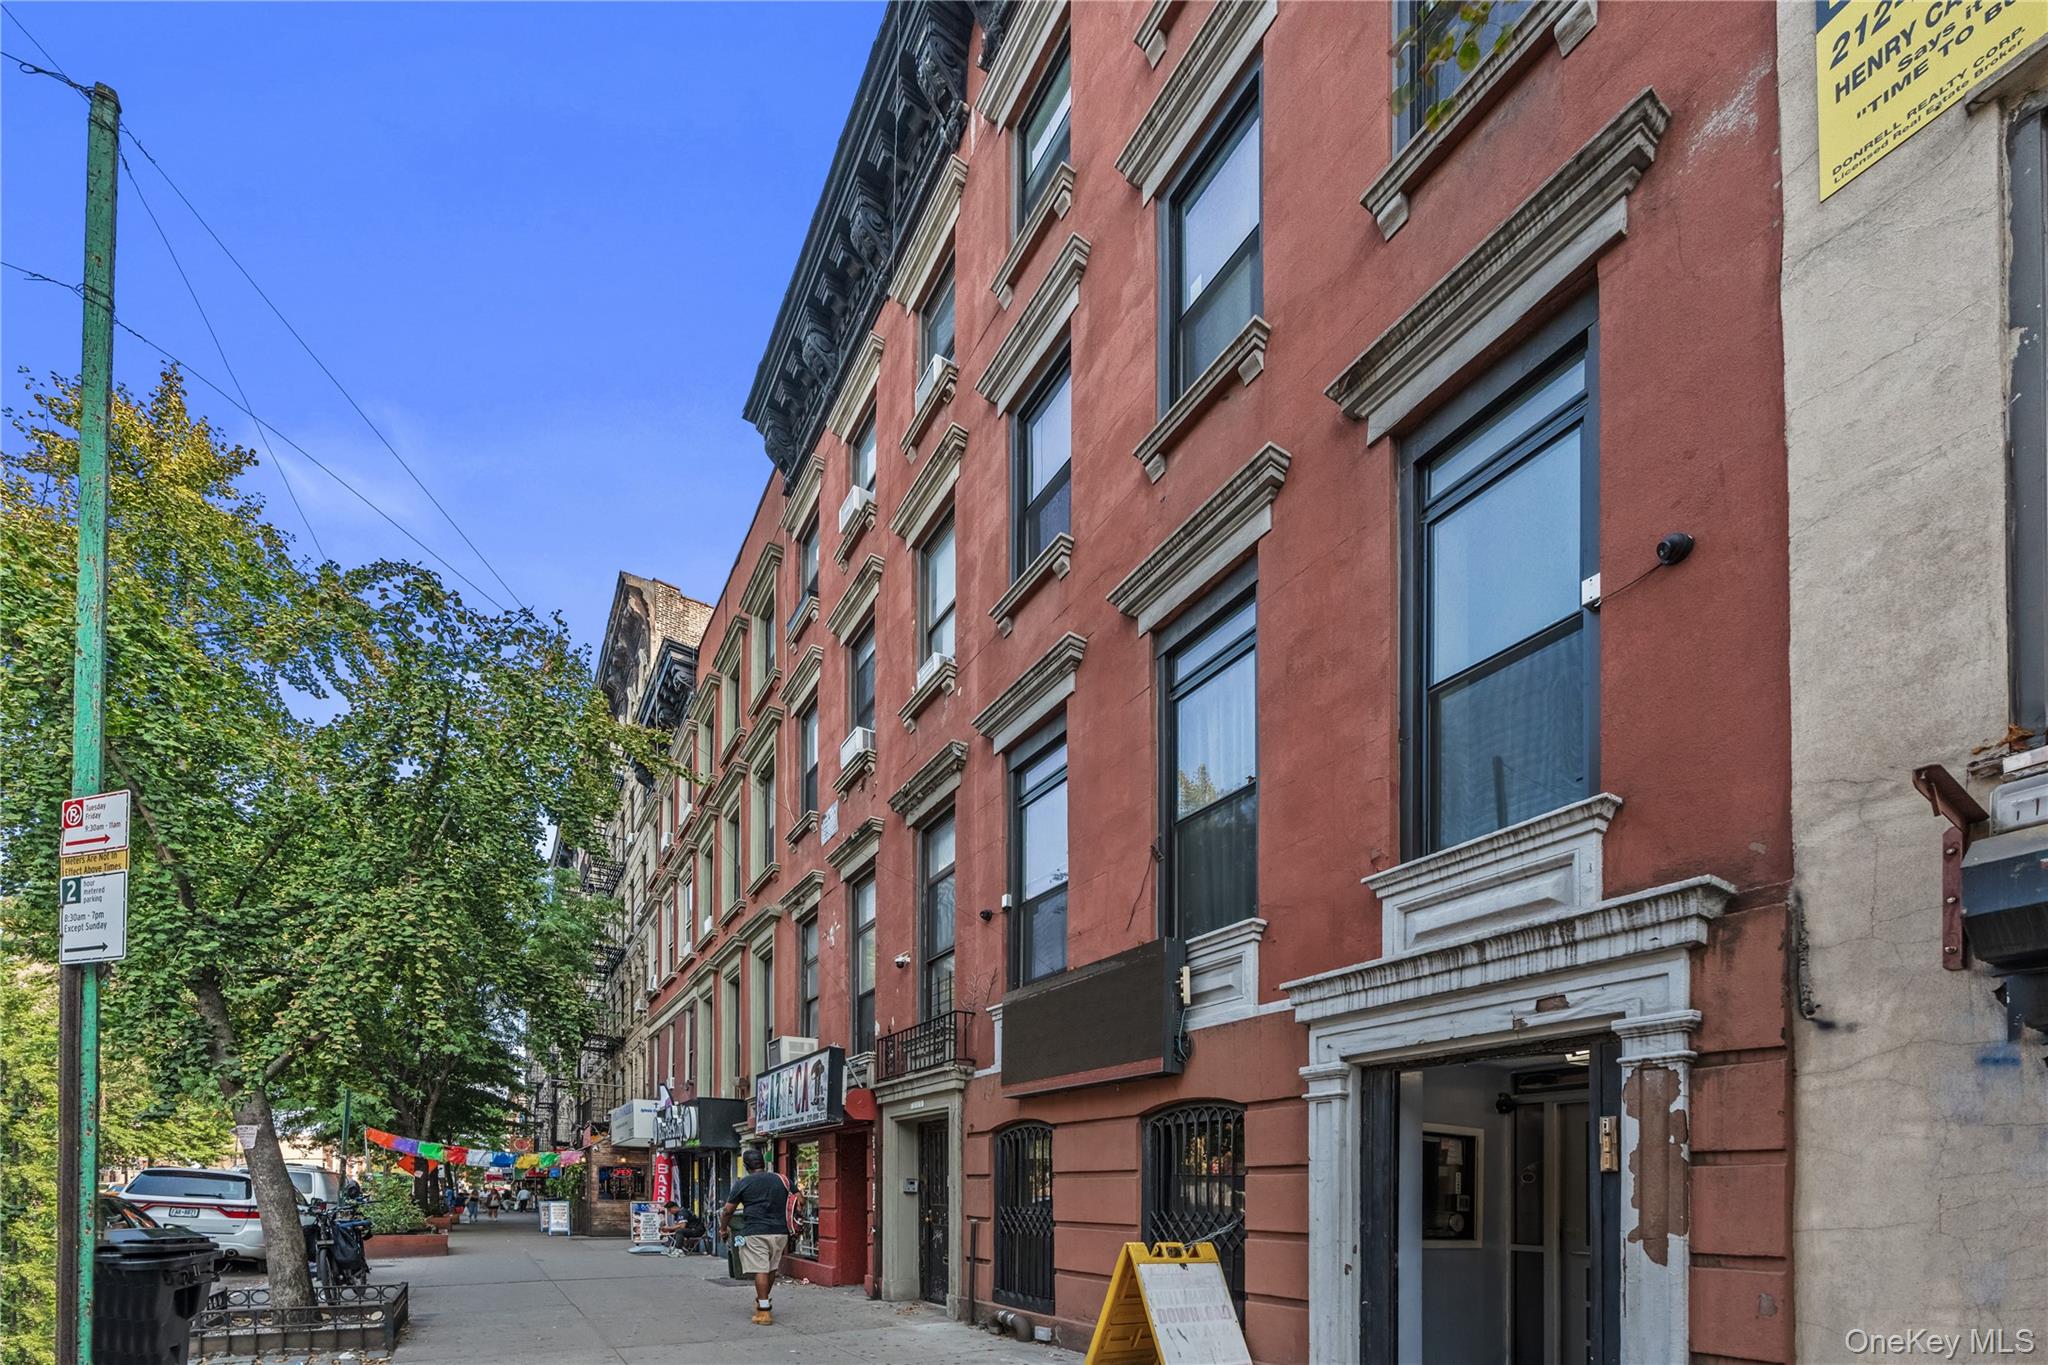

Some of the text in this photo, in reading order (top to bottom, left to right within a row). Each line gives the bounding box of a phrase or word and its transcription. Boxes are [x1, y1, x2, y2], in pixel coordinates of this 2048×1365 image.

[1897, 22, 1956, 72] says
[1937, 25, 1974, 57] TO
[1835, 19, 1917, 104] HENRY
[1832, 26, 2026, 176] DONRELL REALTY CORP.
[1833, 38, 2024, 184] Licensed Real Estate Broker
[85, 803, 106, 812] Tuesday
[85, 812, 101, 820] Friday
[85, 823, 104, 833] 9:30am
[64, 852, 118, 866] Meters Are Not In
[64, 863, 122, 876] Effect Above Times
[83, 879, 95, 888] hour
[66, 880, 77, 902] 2
[83, 886, 105, 895] metered
[83, 894, 103, 904] parking
[64, 913, 86, 923] 8:30am
[91, 911, 105, 922] 7pm
[64, 920, 108, 933] Except Sunday
